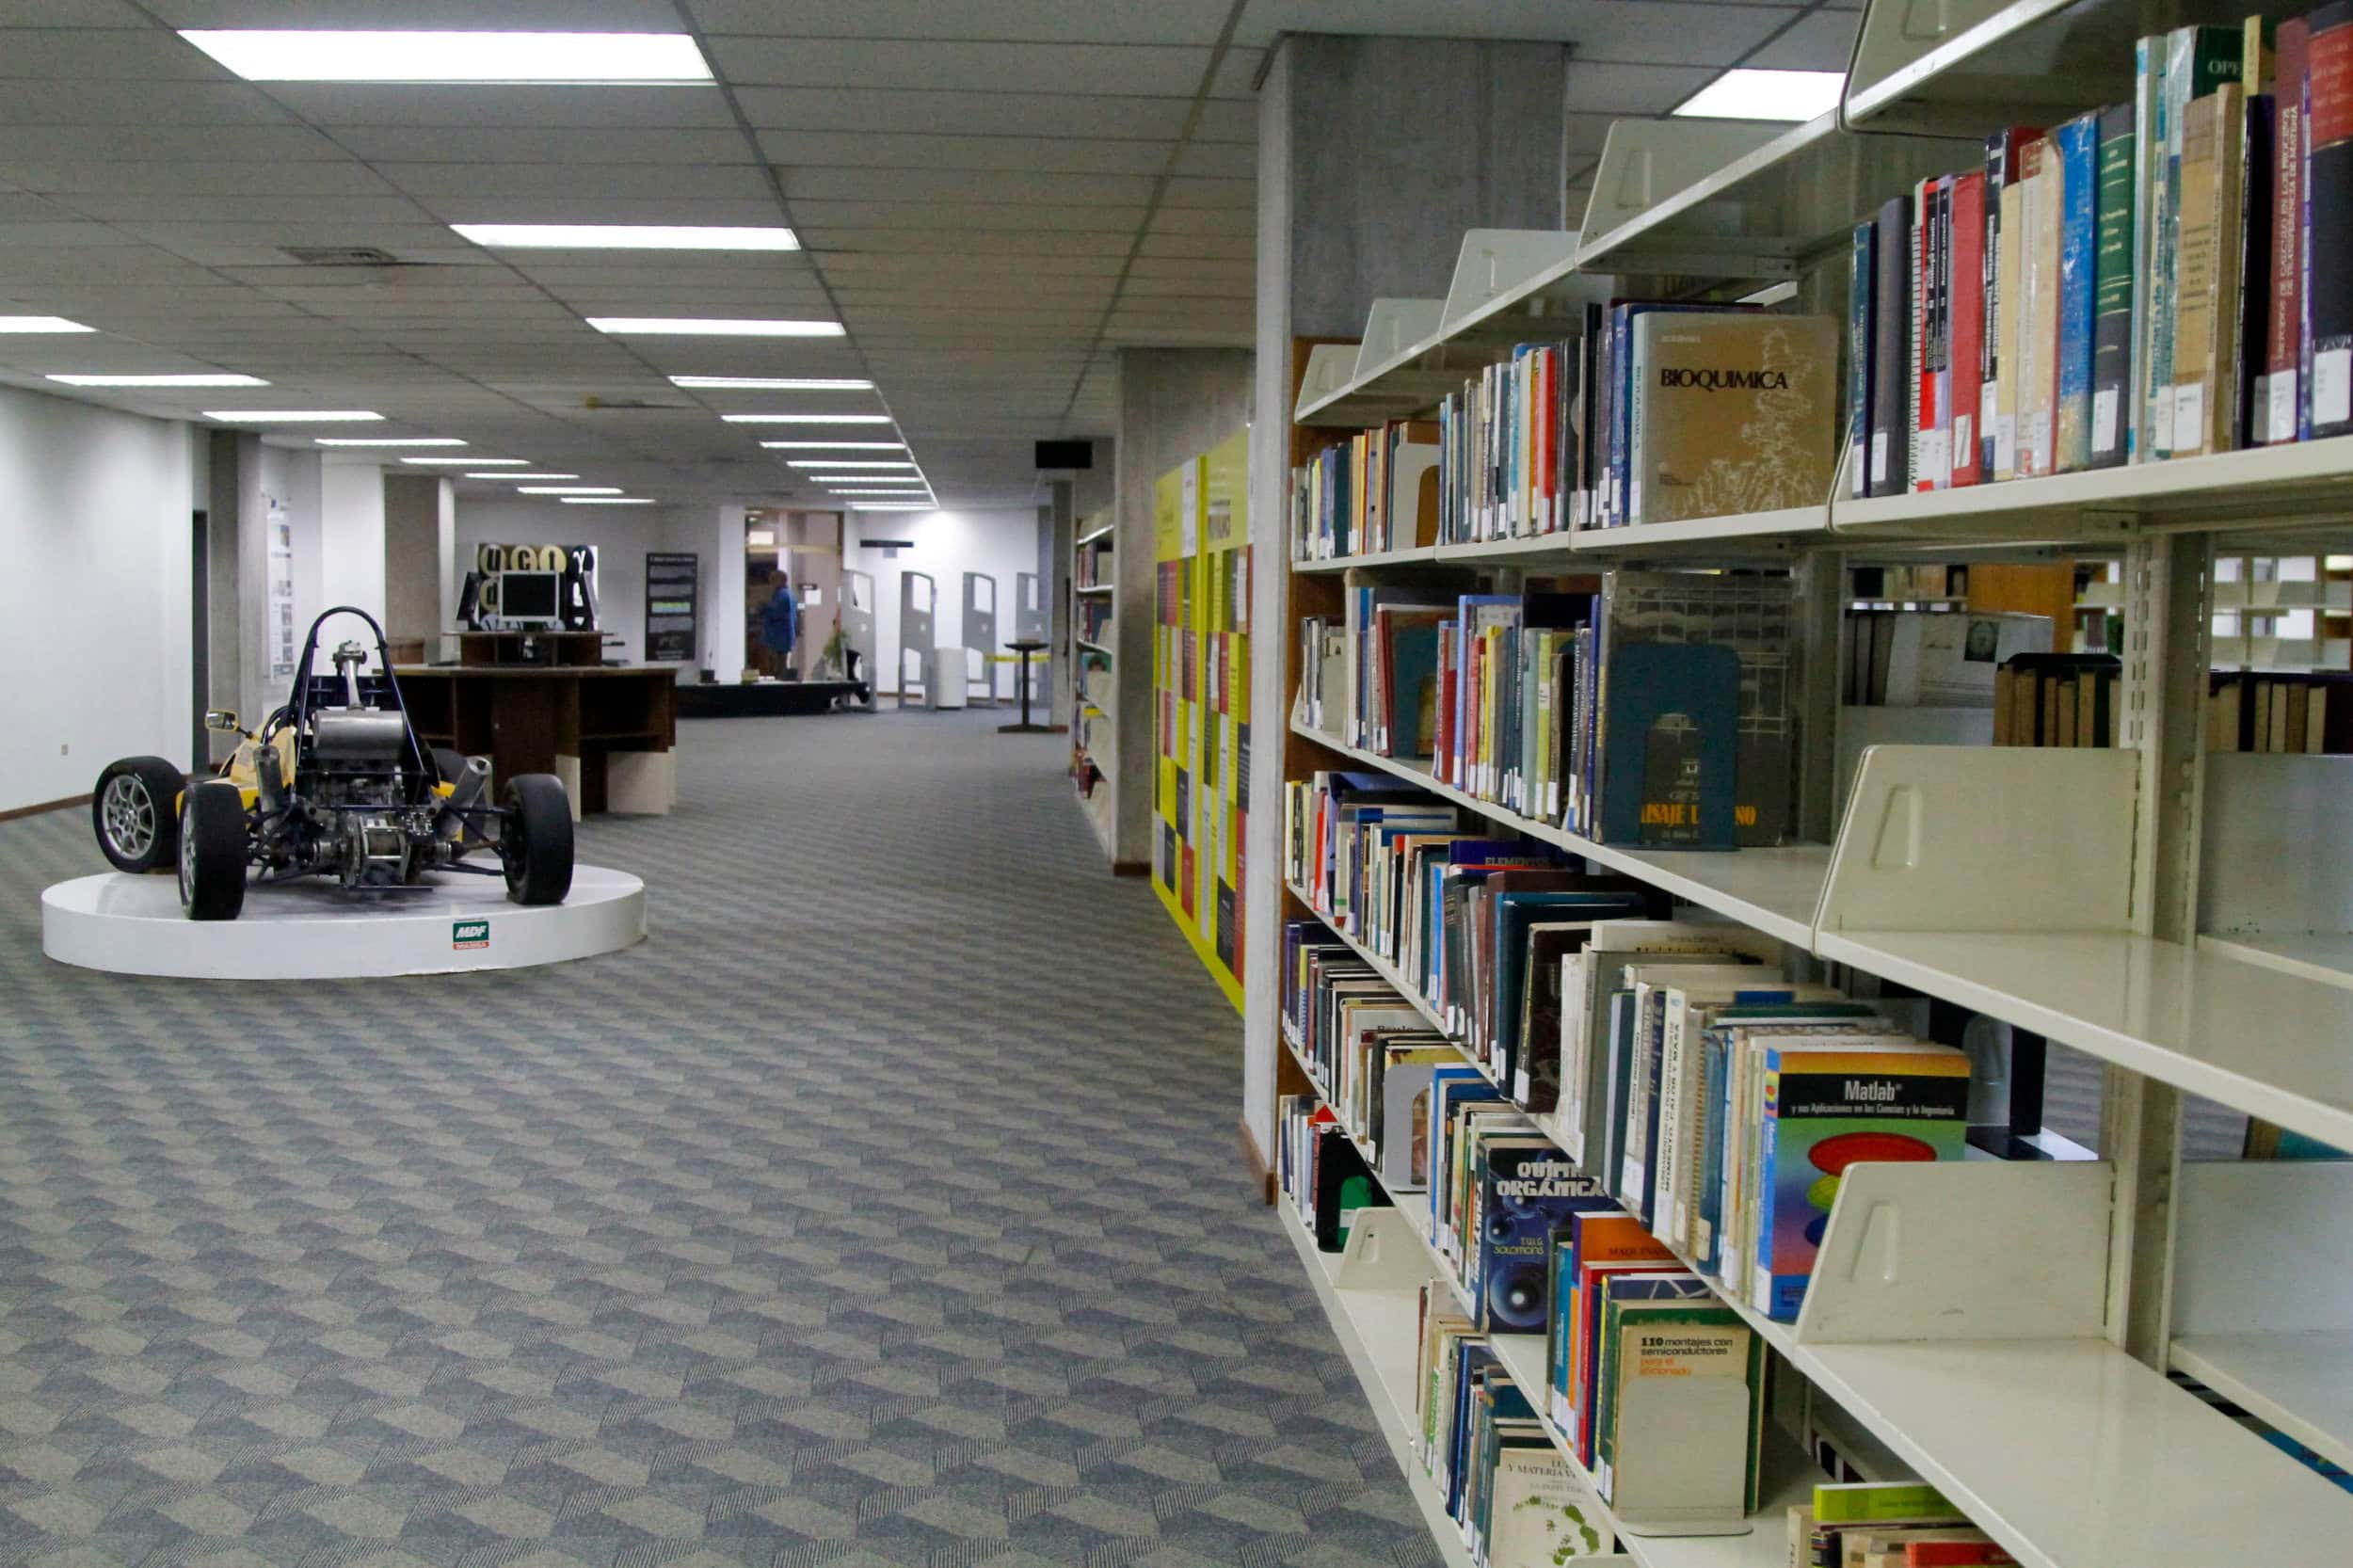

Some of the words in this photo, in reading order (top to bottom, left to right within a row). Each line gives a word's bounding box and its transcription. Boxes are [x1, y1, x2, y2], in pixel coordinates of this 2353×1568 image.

[1660, 368, 1788, 392] BIOQUIMICA
[1845, 1080, 1896, 1101] Matlab
[1641, 1337, 1664, 1347] 110
[1665, 1337, 1711, 1349] montajes
[1641, 1347, 1728, 1356] semiconductores
[1517, 1464, 1563, 1477] MATERIA
